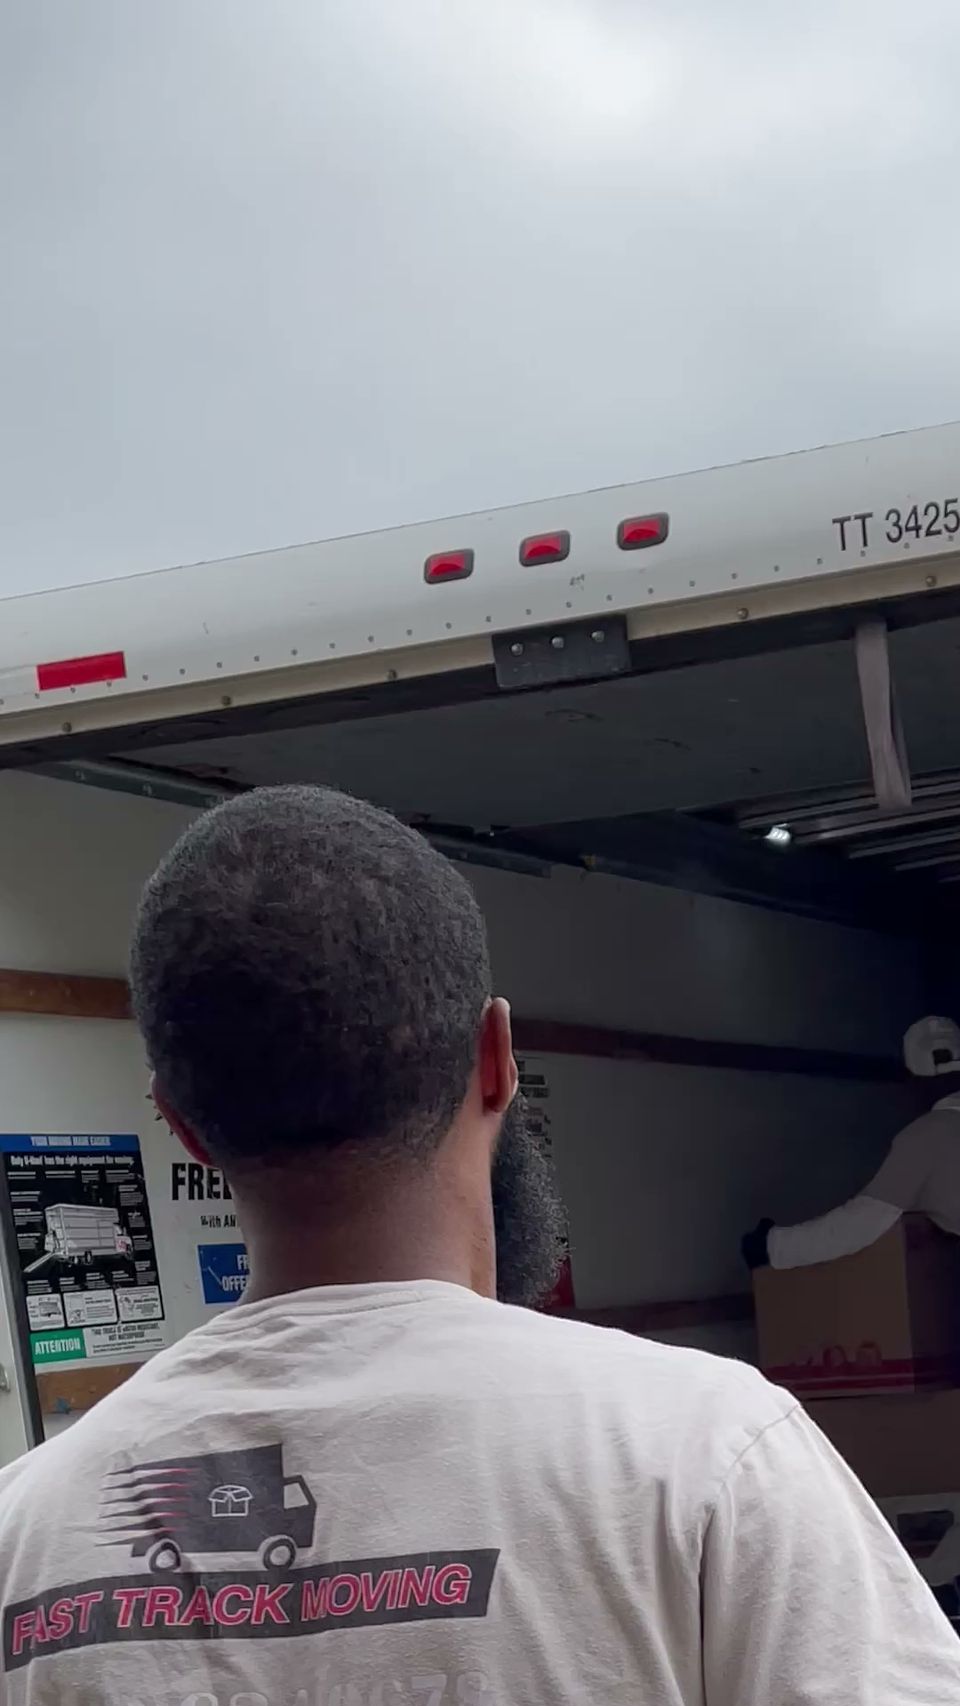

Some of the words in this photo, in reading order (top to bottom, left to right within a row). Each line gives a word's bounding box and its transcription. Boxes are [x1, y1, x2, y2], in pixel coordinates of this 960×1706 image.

[832, 512, 873, 551] TT
[885, 498, 960, 543] 3425
[34, 1337, 82, 1356] ATTENTION
[12, 1591, 104, 1655] FAST
[112, 1583, 295, 1629] TRACK
[301, 1562, 473, 1623] MOVING
